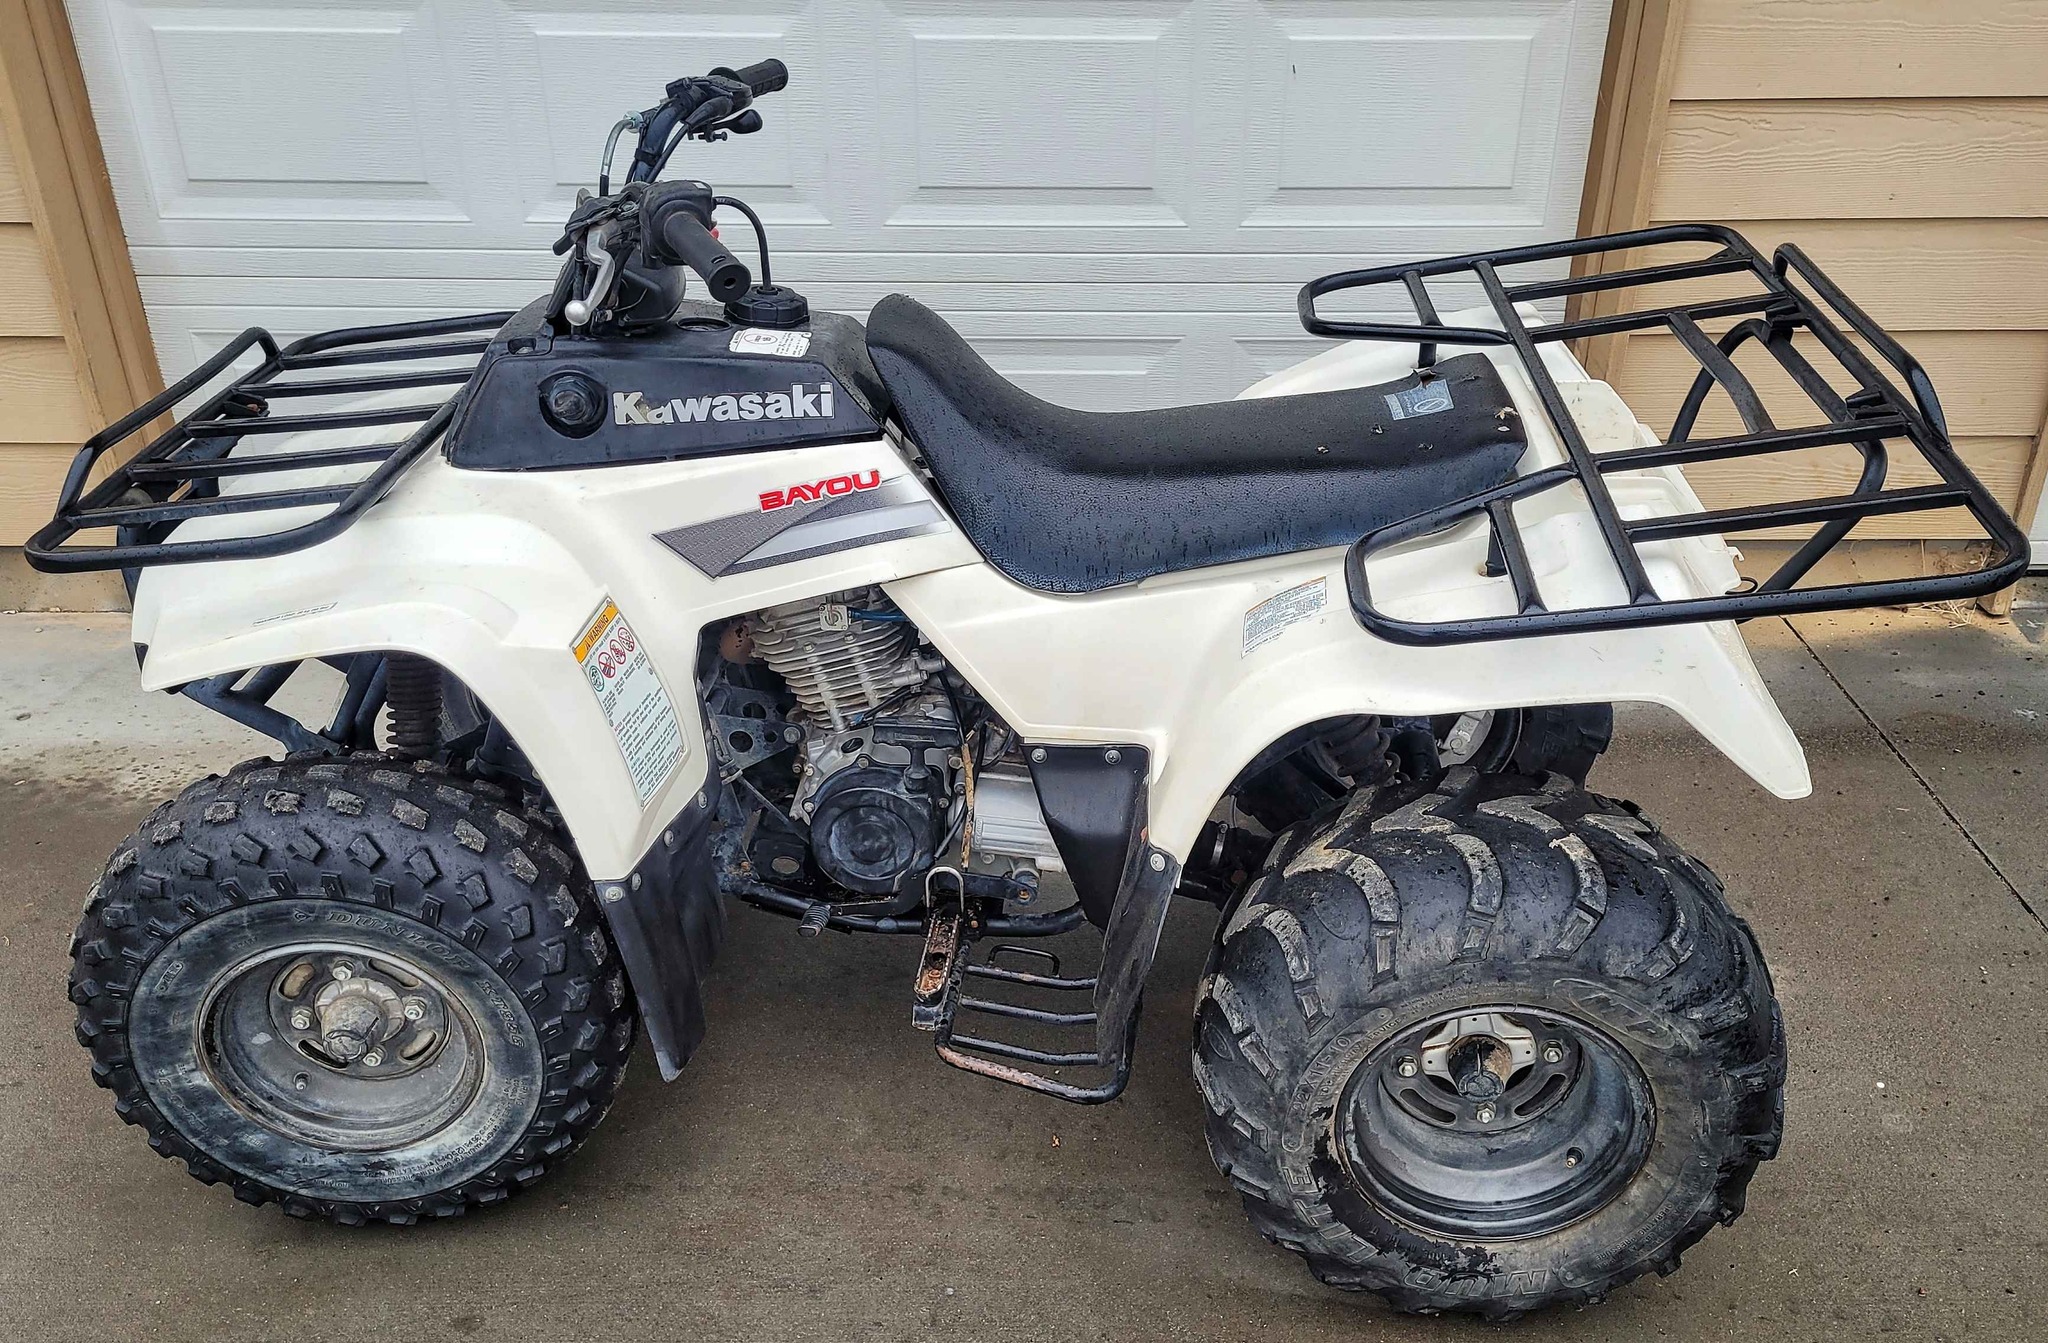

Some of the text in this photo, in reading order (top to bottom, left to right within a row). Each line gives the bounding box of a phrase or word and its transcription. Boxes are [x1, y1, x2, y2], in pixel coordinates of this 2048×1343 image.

[612, 383, 834, 425] Kawasaki
[758, 469, 882, 512] BAYOU
[588, 614, 610, 642] WARNING
[326, 910, 472, 971] DUNLOP
[1281, 1164, 1548, 1297] MUD LITE
